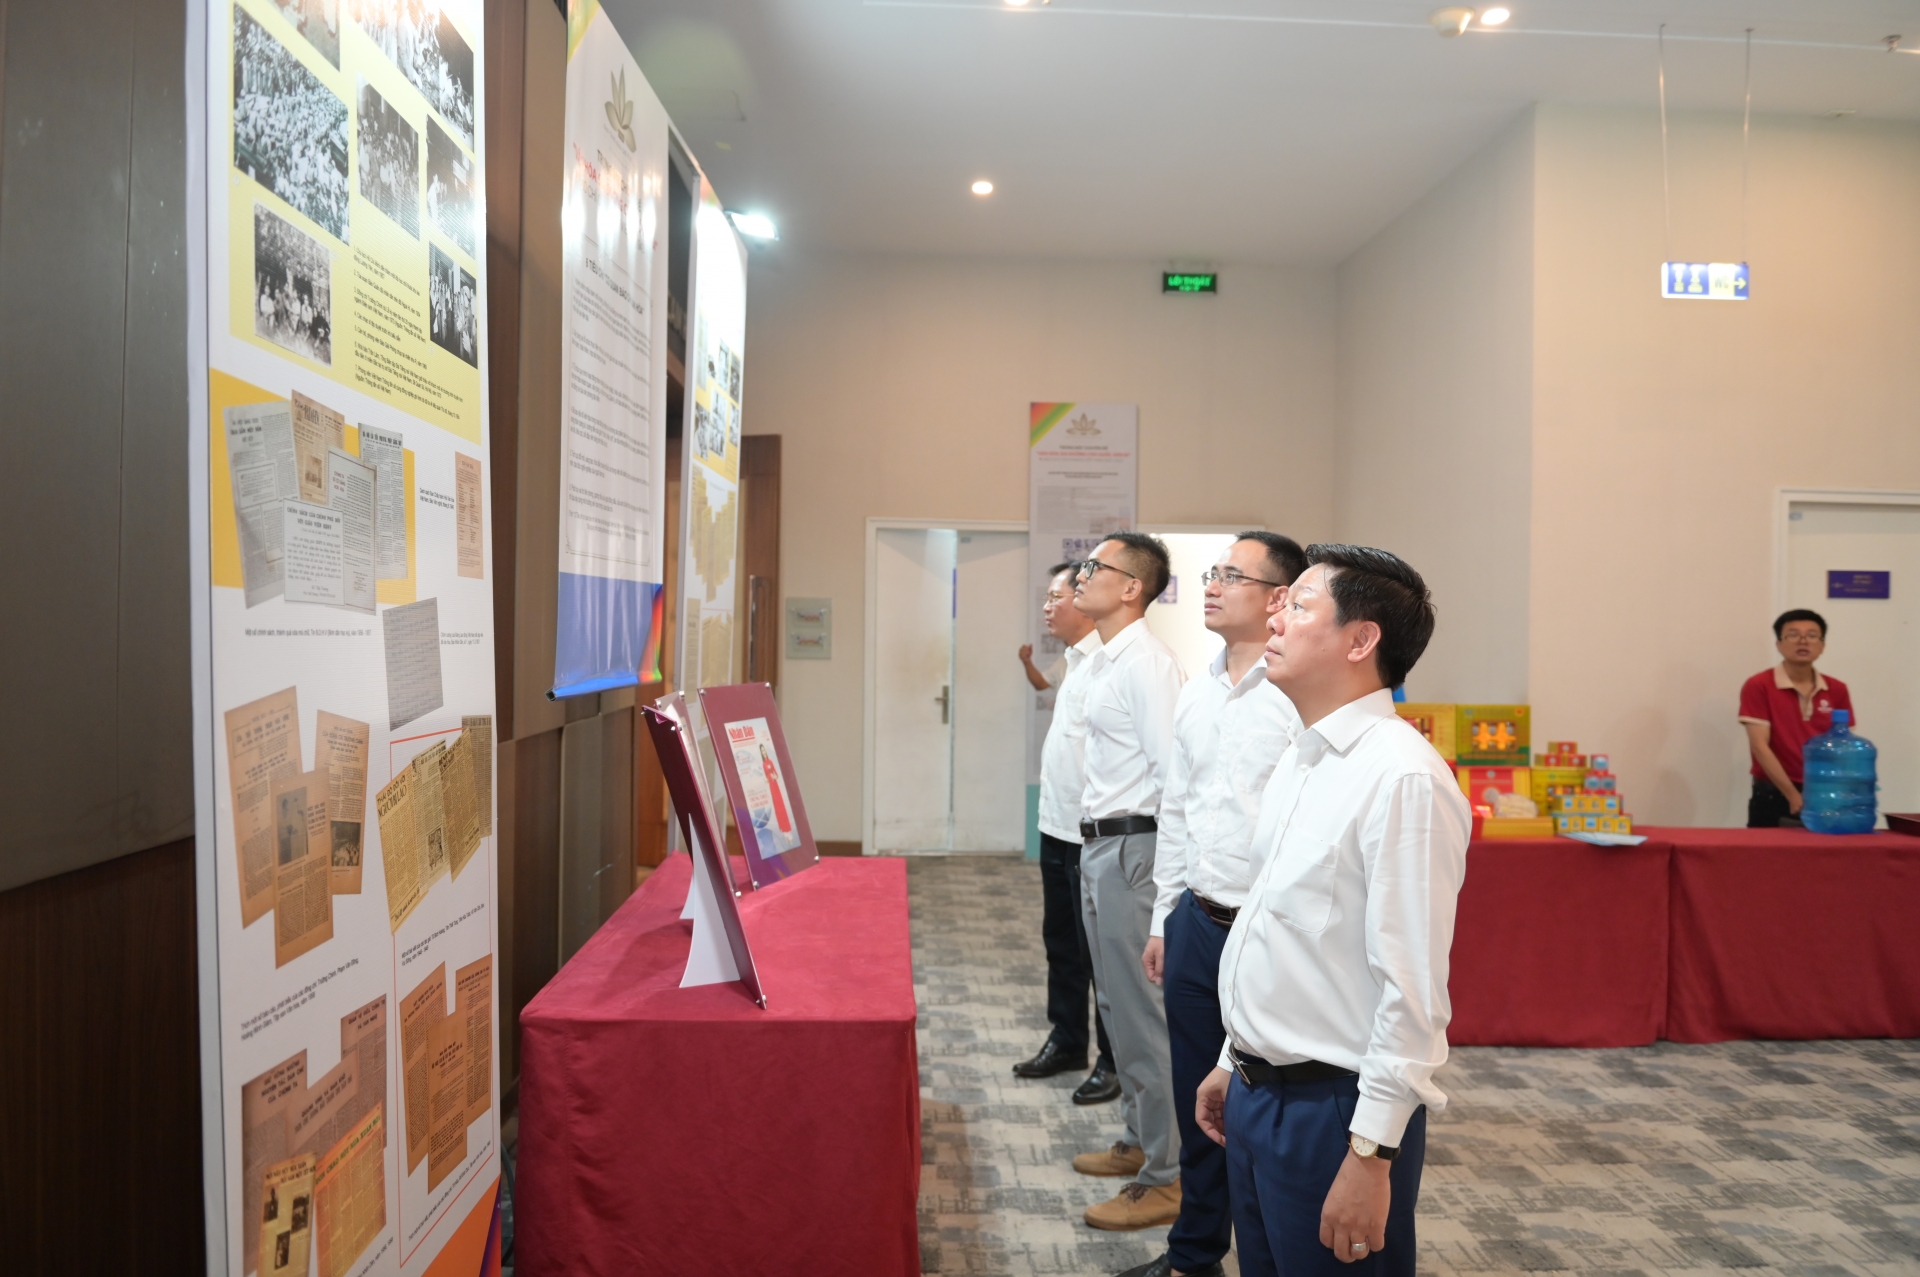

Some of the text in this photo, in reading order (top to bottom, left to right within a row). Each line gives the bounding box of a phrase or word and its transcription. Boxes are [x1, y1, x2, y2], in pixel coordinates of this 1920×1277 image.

[1714, 275, 1729, 289] WC
[729, 725, 755, 739] Nhân Dân
